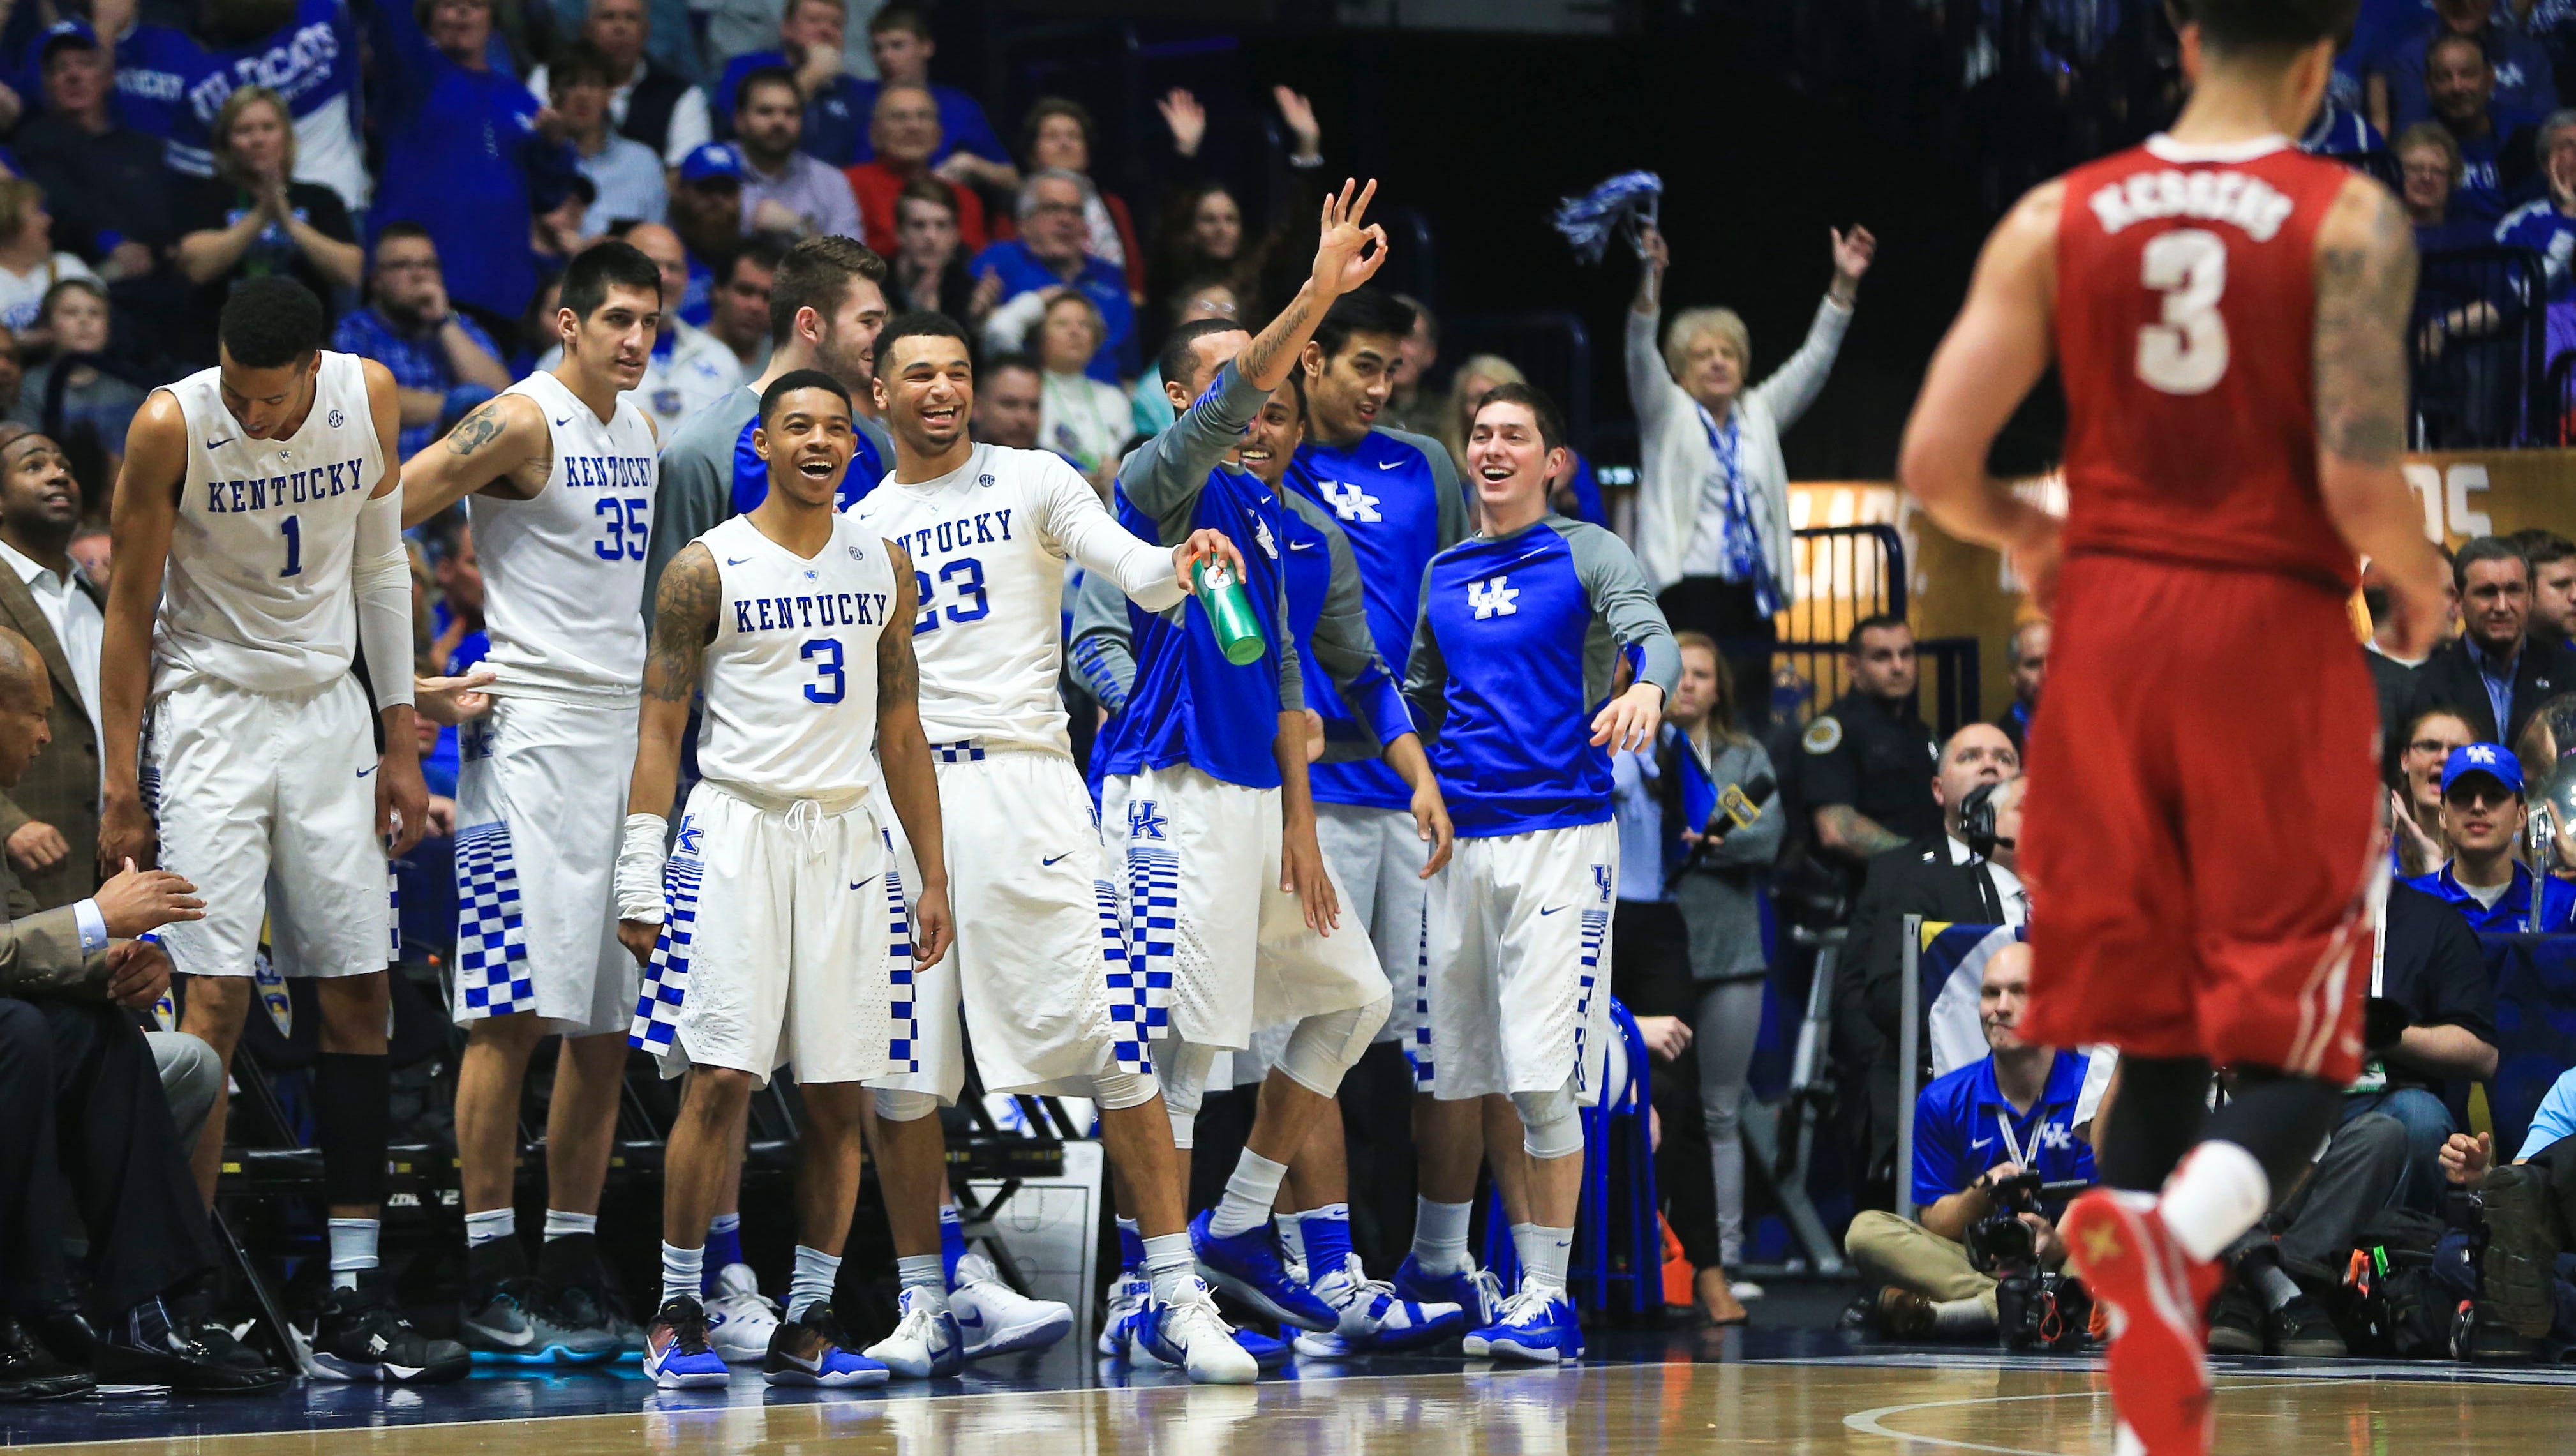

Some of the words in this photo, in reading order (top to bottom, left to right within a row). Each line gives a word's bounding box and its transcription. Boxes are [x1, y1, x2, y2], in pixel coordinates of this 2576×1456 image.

[2136, 227, 2231, 396] 3
[207, 457, 362, 513] KENTUCKY
[564, 456, 653, 488] KENTUCKY
[979, 474, 995, 488] SEC
[1318, 480, 1383, 522] UK
[280, 514, 302, 577] 1
[595, 497, 648, 561] 35
[897, 509, 1011, 557] NTUCKY
[734, 593, 887, 633] KENTUCKY
[912, 557, 990, 637] 23
[1468, 575, 1520, 620] UK
[800, 638, 845, 705] 3
[2466, 745, 2496, 765] UK
[1128, 800, 1168, 841] UK
